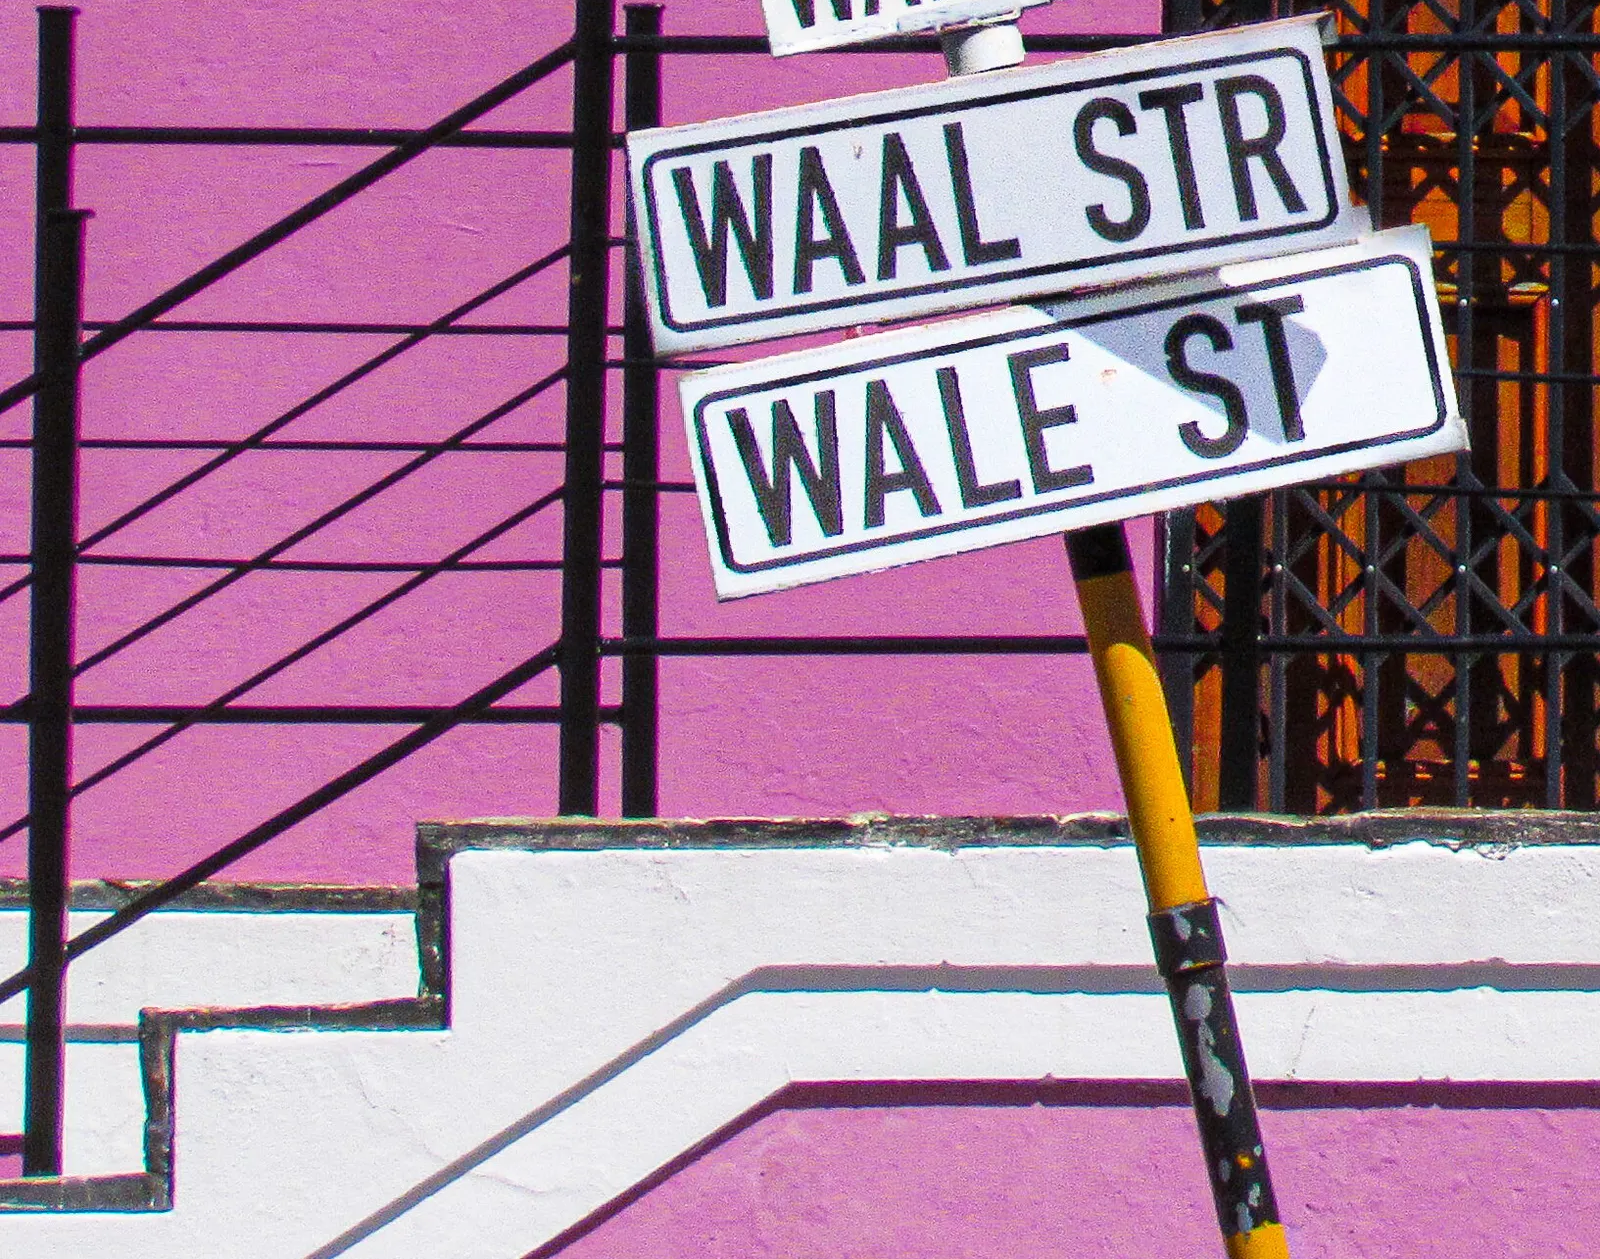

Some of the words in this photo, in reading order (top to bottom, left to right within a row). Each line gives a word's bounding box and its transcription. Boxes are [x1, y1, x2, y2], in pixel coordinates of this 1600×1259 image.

[671, 121, 1022, 309] WAAL
[1072, 74, 1308, 243] STR
[724, 342, 1095, 548] WALE
[1161, 294, 1306, 460] ST
